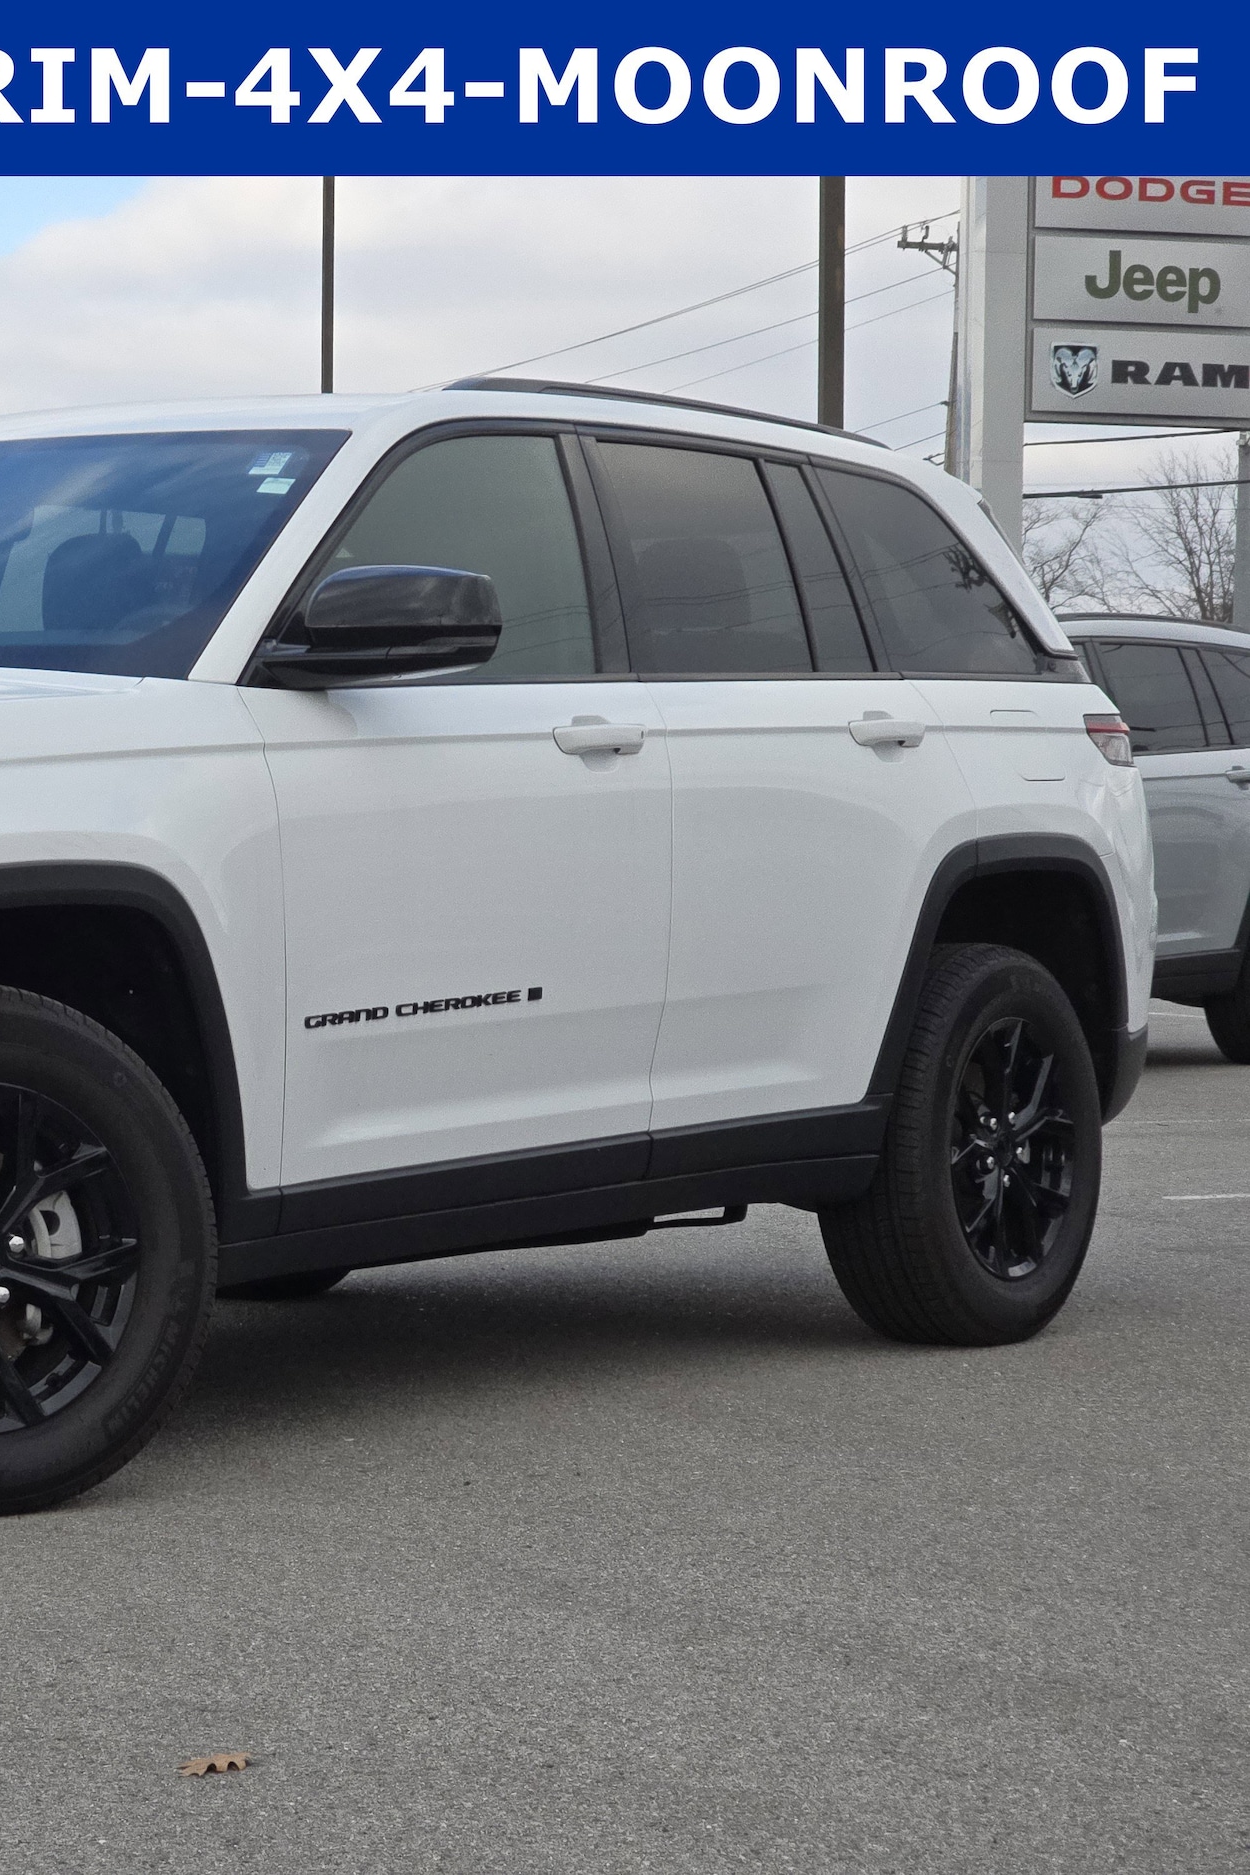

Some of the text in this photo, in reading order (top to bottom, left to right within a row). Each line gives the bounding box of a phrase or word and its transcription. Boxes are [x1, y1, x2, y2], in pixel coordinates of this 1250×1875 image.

[1051, 176, 1250, 206] DODGE
[1084, 250, 1221, 313] Jeep
[1111, 360, 1250, 389] RAM
[304, 990, 521, 1029] GRAND CHEROKEE
